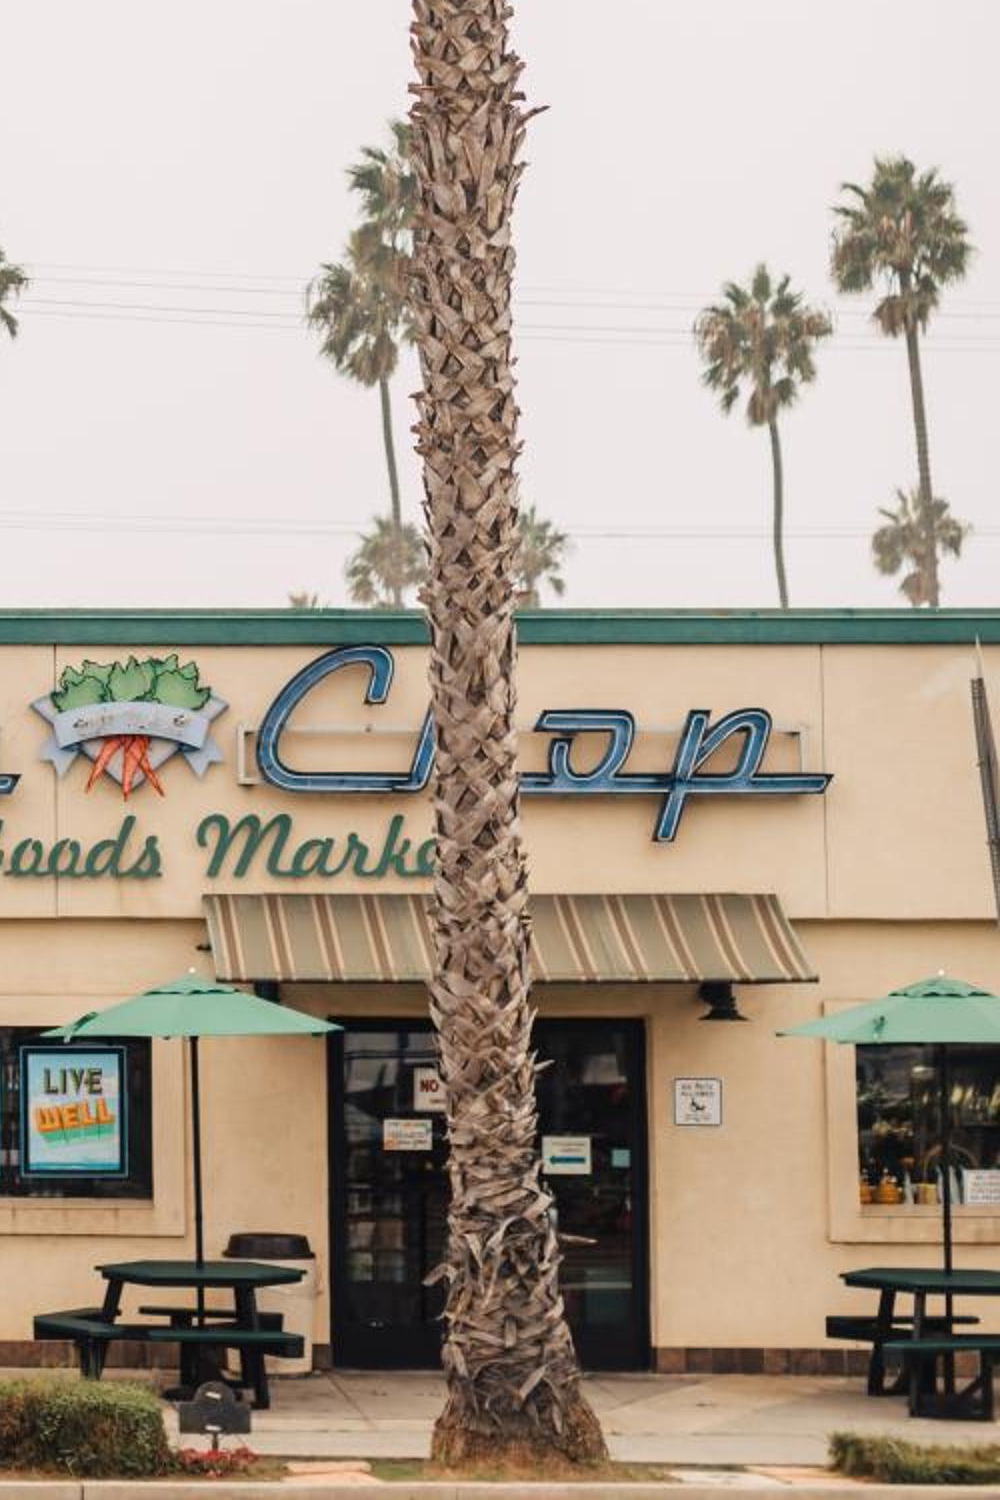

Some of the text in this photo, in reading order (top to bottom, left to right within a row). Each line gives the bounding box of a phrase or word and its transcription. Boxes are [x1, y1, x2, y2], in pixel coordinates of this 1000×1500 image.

[43, 1067, 104, 1095] LIVE
[419, 1079, 440, 1093] NO
[36, 1097, 115, 1134] WELL
